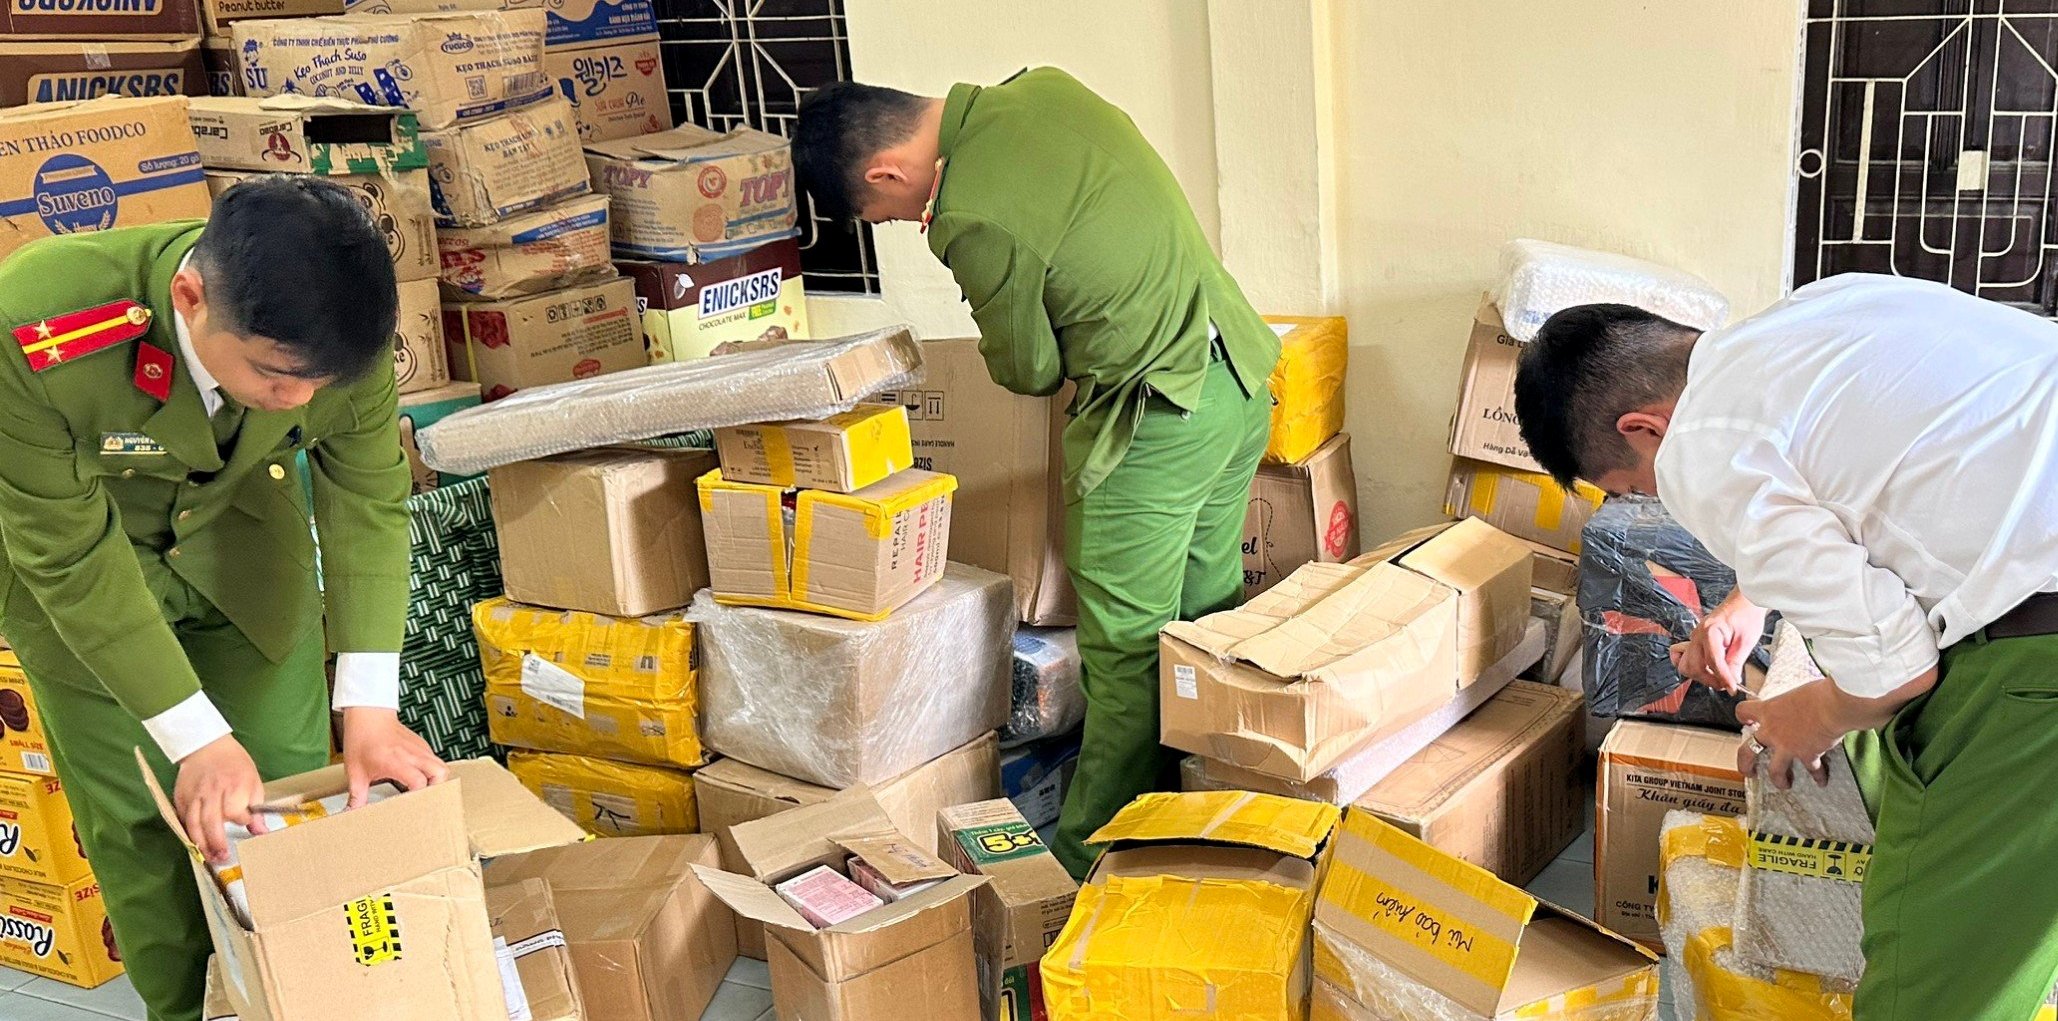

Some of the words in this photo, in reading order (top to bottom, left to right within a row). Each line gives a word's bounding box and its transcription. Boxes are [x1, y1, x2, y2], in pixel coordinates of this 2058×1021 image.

[219, 3, 254, 12] Peanut
[573, 56, 628, 97] 웰키즈
[77, 122, 146, 145] FOODCO
[38, 187, 115, 217] Suveno
[703, 271, 779, 315] ENICKSRS
[699, 316, 732, 331] CHOCOLATE
[1242, 536, 1257, 555] el
[914, 532, 926, 584] HAIR
[1627, 774, 1642, 783] KITA
[1644, 776, 1668, 787] GROUP
[1670, 778, 1702, 791] VIETNAM
[1704, 786, 1726, 796] JOINT
[1758, 853, 1816, 870] FRAGILE
[1616, 900, 1641, 910] CÔNG
